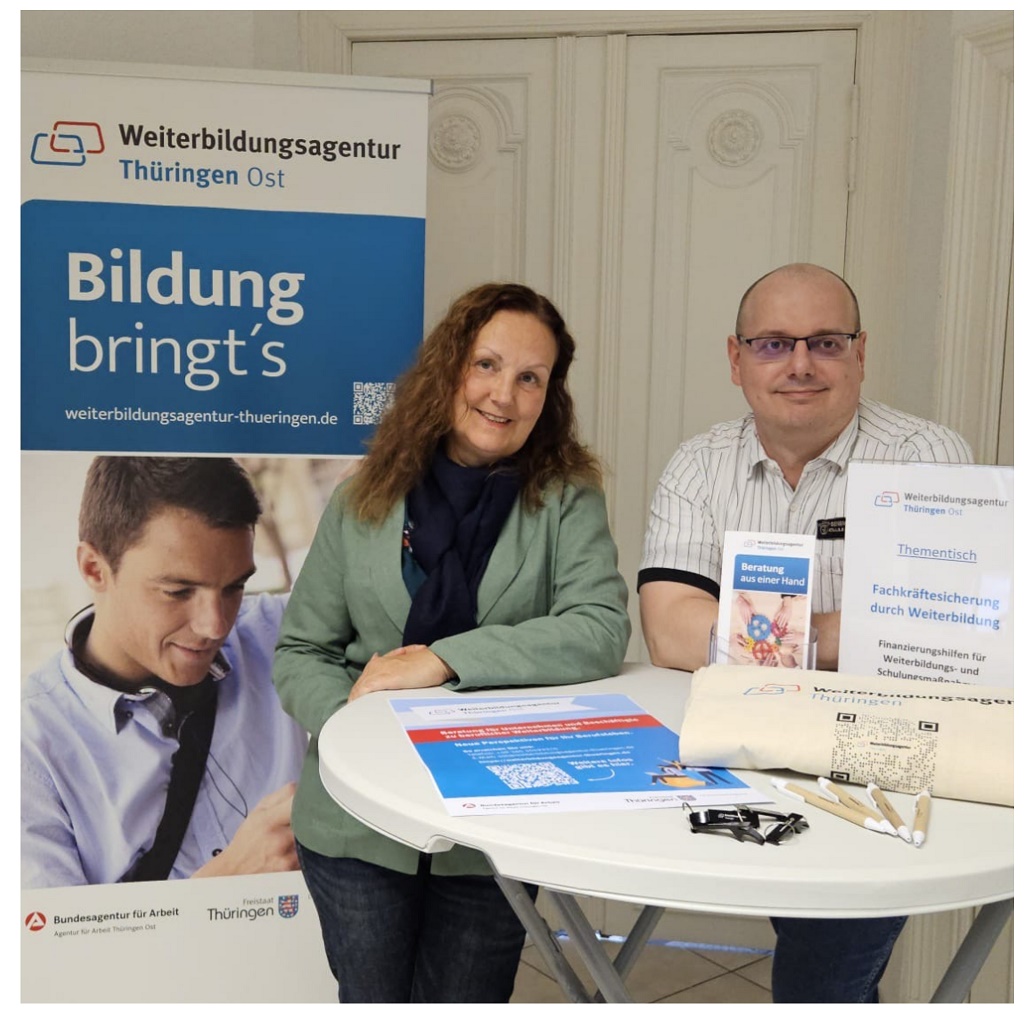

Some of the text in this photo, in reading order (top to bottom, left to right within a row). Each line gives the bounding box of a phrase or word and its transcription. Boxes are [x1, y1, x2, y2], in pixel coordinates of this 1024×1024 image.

[119, 123, 401, 162] Weiterbildungsagentur
[119, 159, 285, 189] Thüringen Ost
[67, 247, 305, 326] Bildung
[65, 407, 339, 428] weiterbildungsagentur-thueringen.de
[904, 492, 1009, 508] Weiterbildungsagentur
[904, 504, 963, 516] Thüringen Ost
[897, 543, 977, 561] Thementisch
[741, 562, 785, 574] Beratung
[740, 575, 805, 586] aus einer Hand
[872, 584, 1000, 610] Fachkräftesicherung
[870, 602, 1000, 630] durch Weiterbildung
[878, 639, 987, 663] Finanzierungshilfen für
[883, 654, 979, 676] Weiterbildungs- und
[812, 693, 902, 706] Thüringen
[243, 897, 274, 905] Freistaat
[54, 907, 179, 925] Bundesagentur für Arbeit
[207, 907, 274, 921] Thüringen
[54, 929, 79, 938] Agentur
[91, 927, 111, 935] Arbeit
[113, 925, 144, 934] Thüringen
